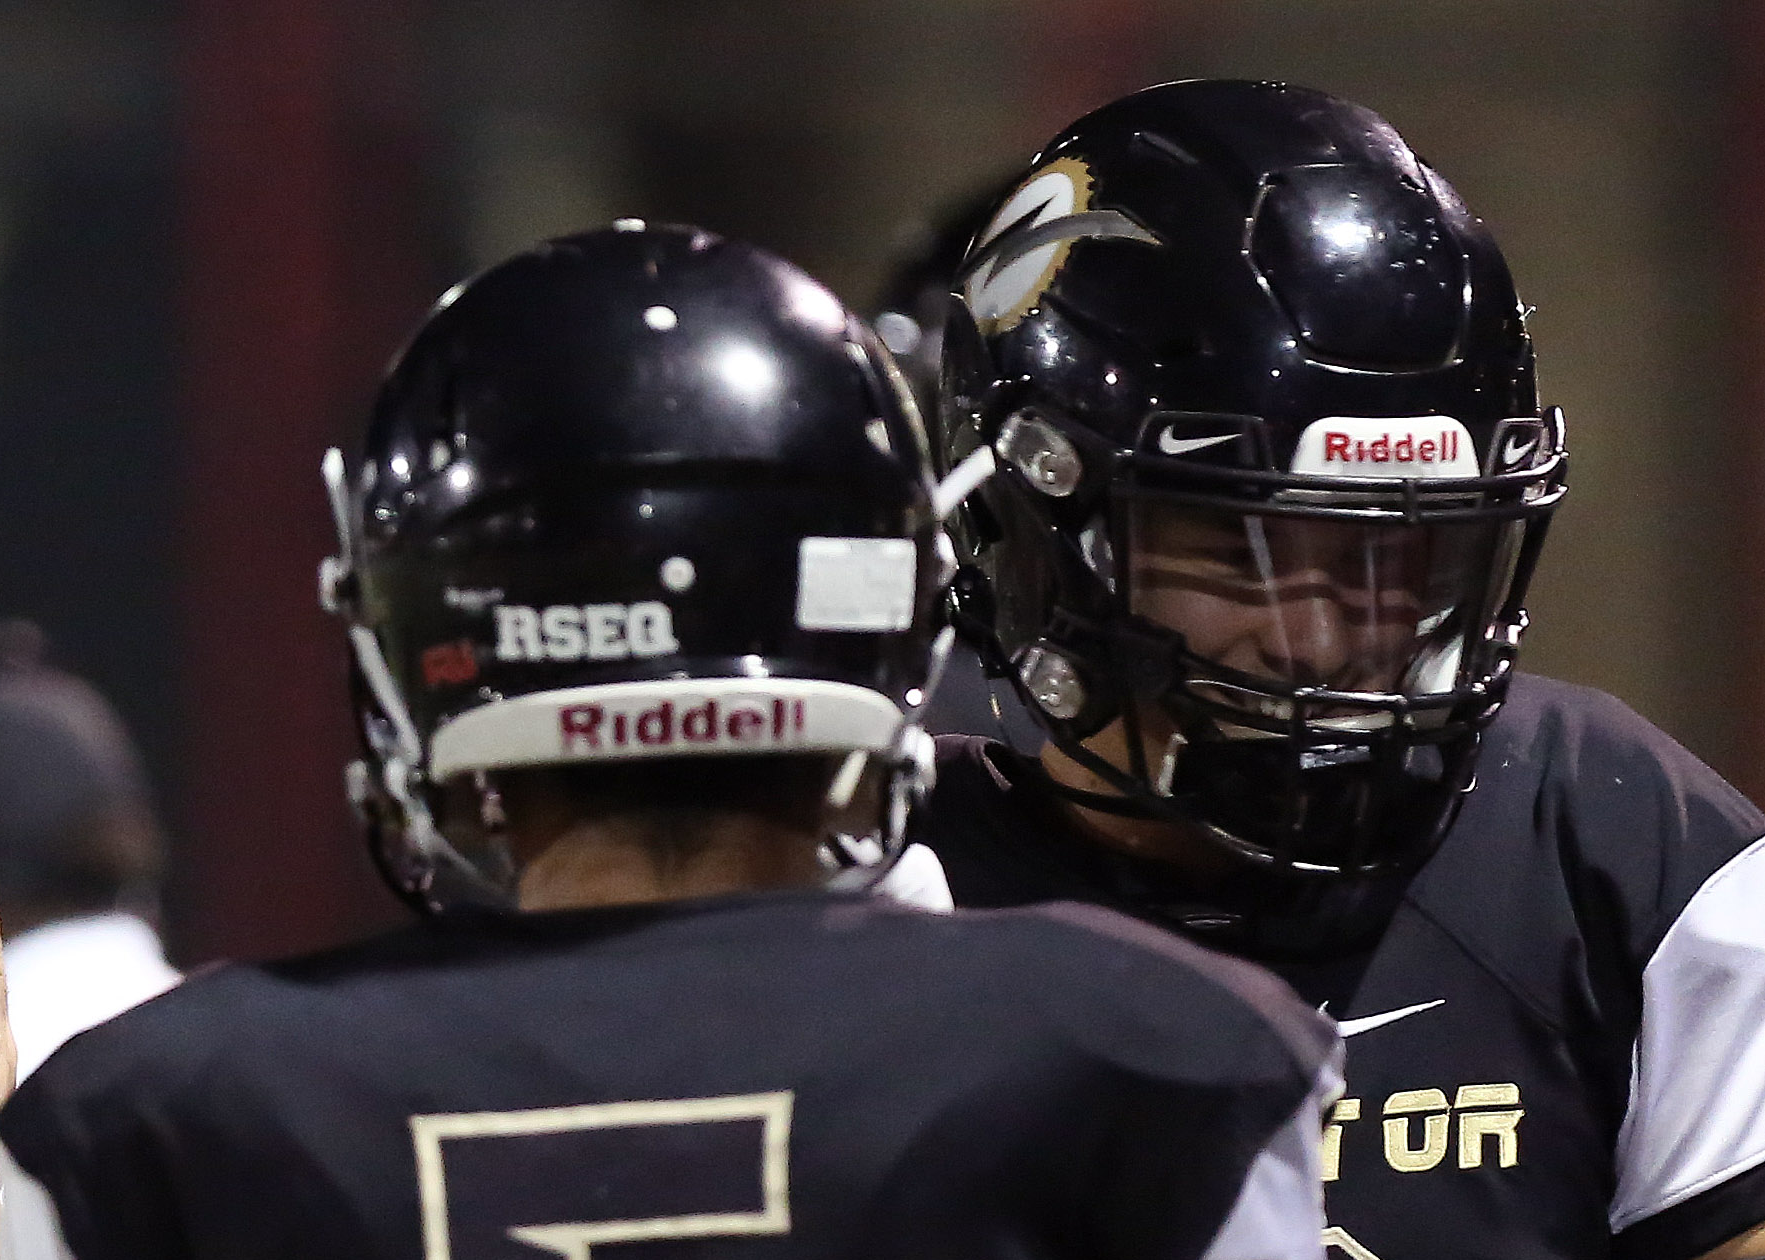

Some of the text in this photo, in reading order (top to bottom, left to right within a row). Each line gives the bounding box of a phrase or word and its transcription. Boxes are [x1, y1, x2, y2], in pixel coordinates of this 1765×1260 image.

[1322, 430, 1459, 464] Riddell
[493, 600, 680, 662] RSEQ
[558, 699, 806, 752] Riddell
[1382, 1082, 1525, 1173] OR
